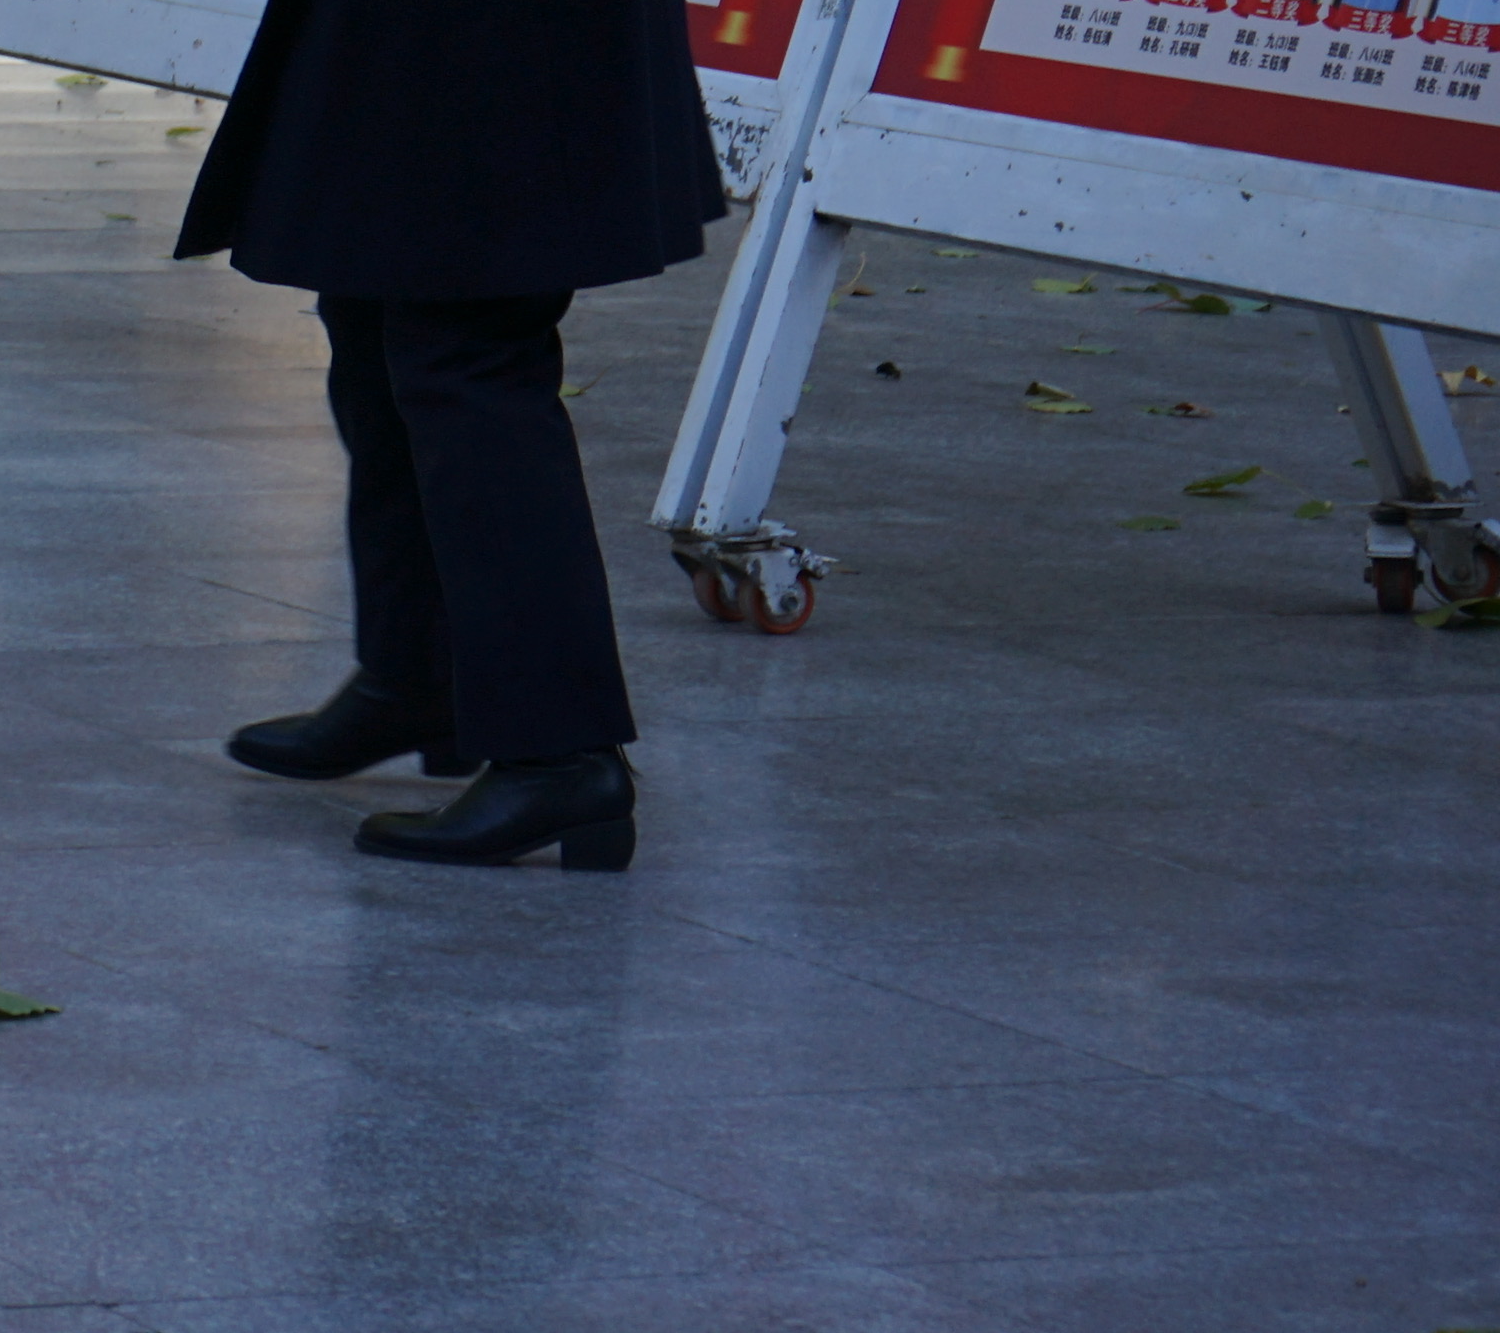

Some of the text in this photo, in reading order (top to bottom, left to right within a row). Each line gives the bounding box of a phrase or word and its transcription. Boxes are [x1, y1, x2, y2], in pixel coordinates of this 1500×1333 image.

[1060, 4, 1123, 26] 班级：八(4)班
[1348, 10, 1394, 34] 三等奖
[1443, 22, 1491, 47] 三等奖
[1327, 41, 1396, 65] 班级：八(4)班
[1421, 54, 1491, 79] 班级：八(4)班
